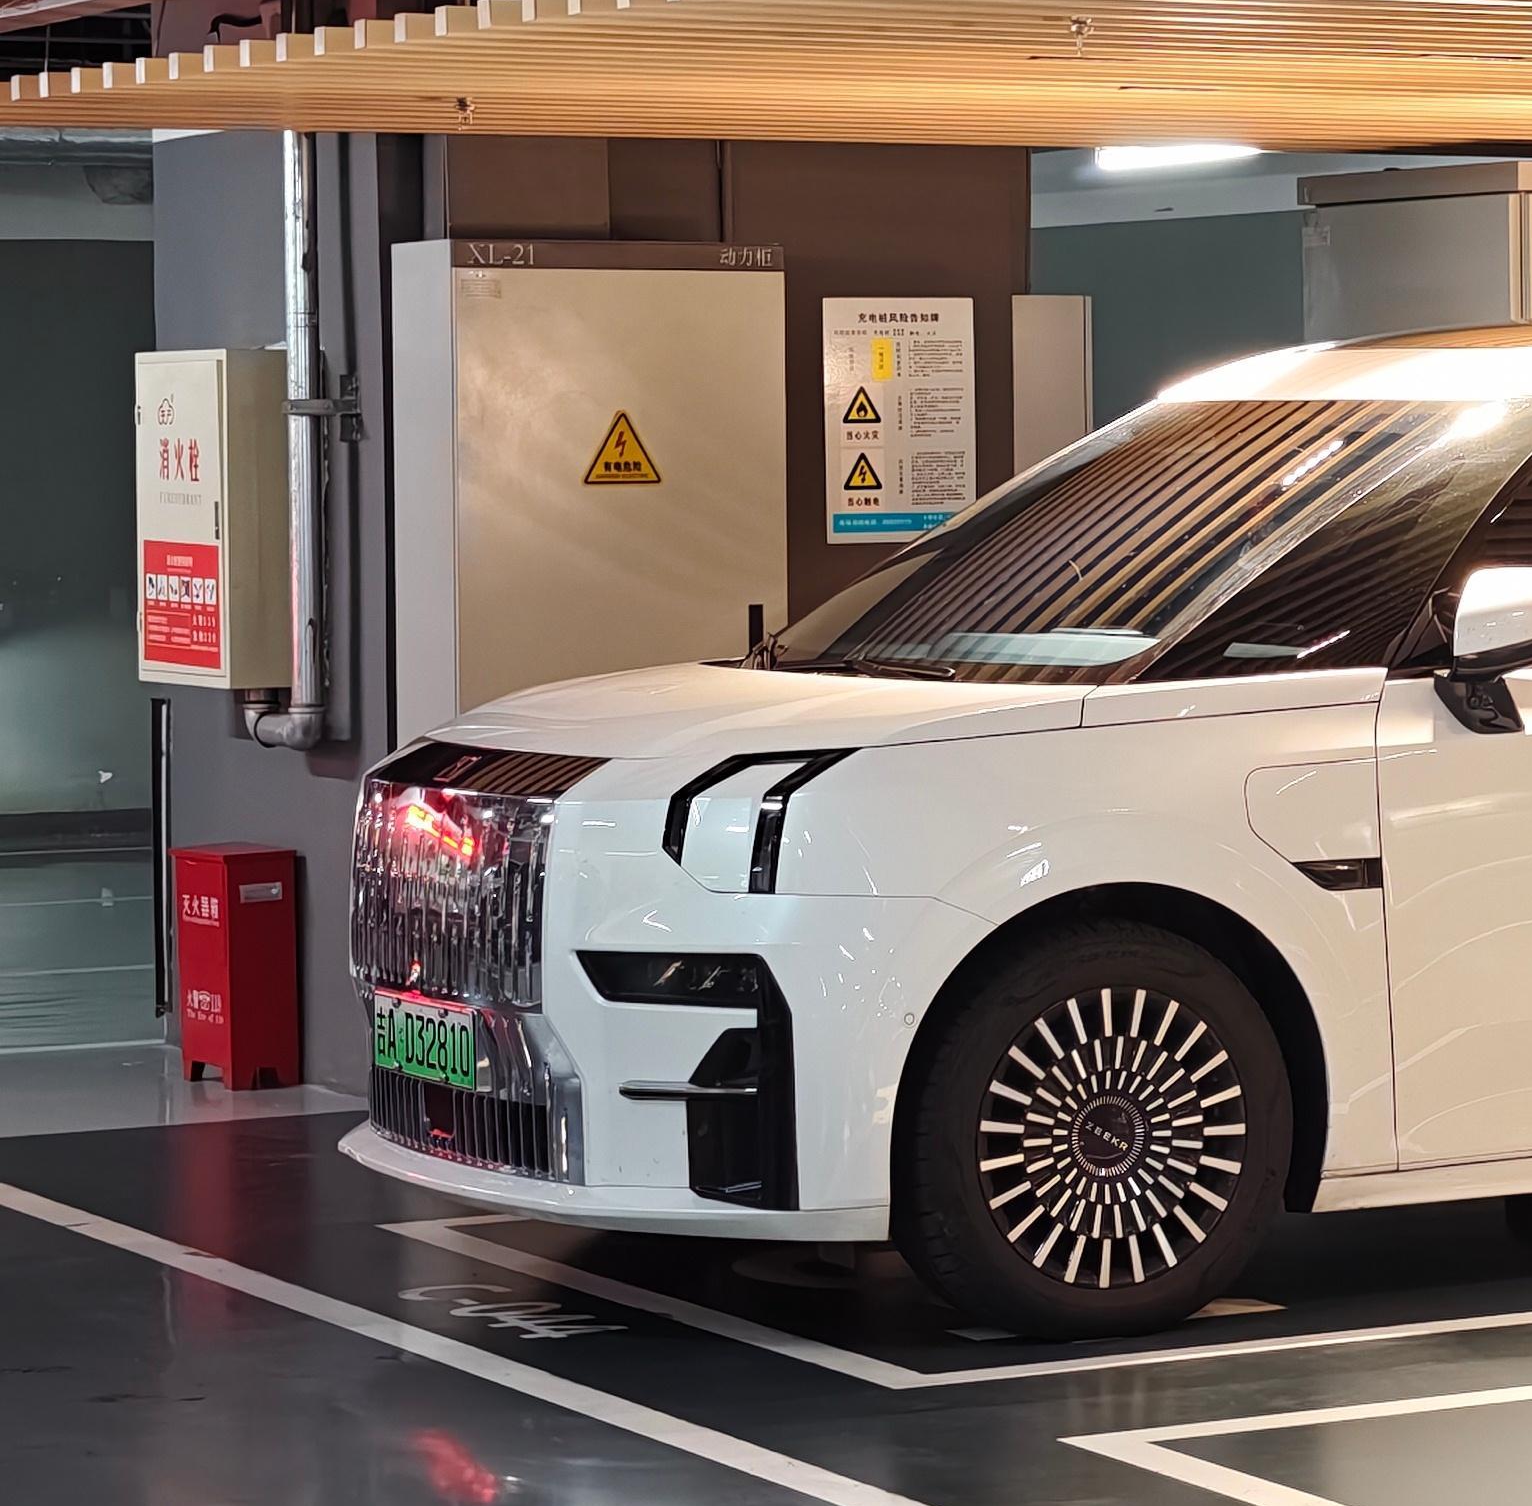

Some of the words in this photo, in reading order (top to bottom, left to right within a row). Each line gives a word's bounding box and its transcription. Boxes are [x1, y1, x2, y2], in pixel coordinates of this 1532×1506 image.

[467, 243, 535, 265] XL-21
[719, 247, 773, 268] 动力柜
[159, 437, 200, 482] 消火栓
[1085, 1121, 1129, 1151] ZEEKR
[397, 1283, 629, 1340] C-044
